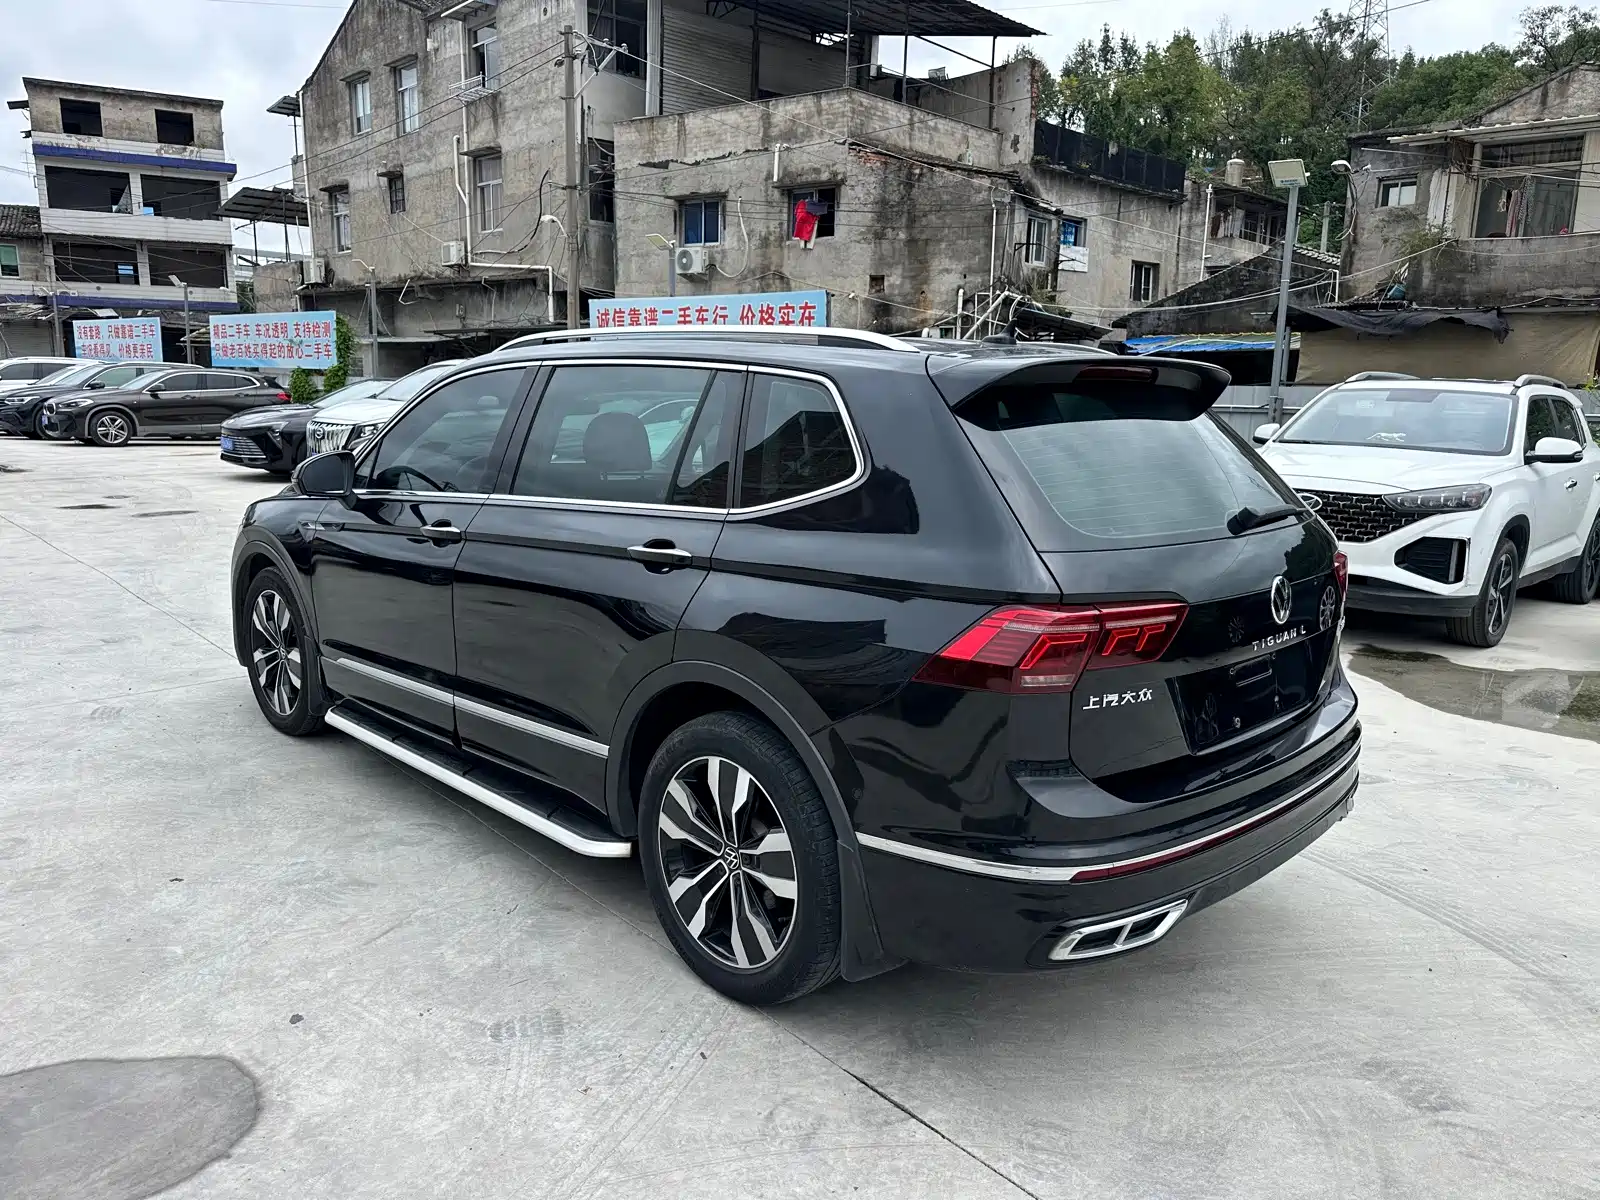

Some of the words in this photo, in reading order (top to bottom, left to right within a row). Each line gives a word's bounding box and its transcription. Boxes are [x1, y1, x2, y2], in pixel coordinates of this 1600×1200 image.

[739, 301, 817, 327] 价格实在
[213, 323, 250, 339] 精品二手车
[255, 322, 288, 339] 车况透明
[293, 321, 331, 338] 支持检测
[214, 342, 333, 360] 只做老百姓买得起的放心二手车
[1252, 630, 1297, 651] TIGUAN
[1299, 625, 1307, 635] L
[1082, 688, 1153, 710] 上汽大众
